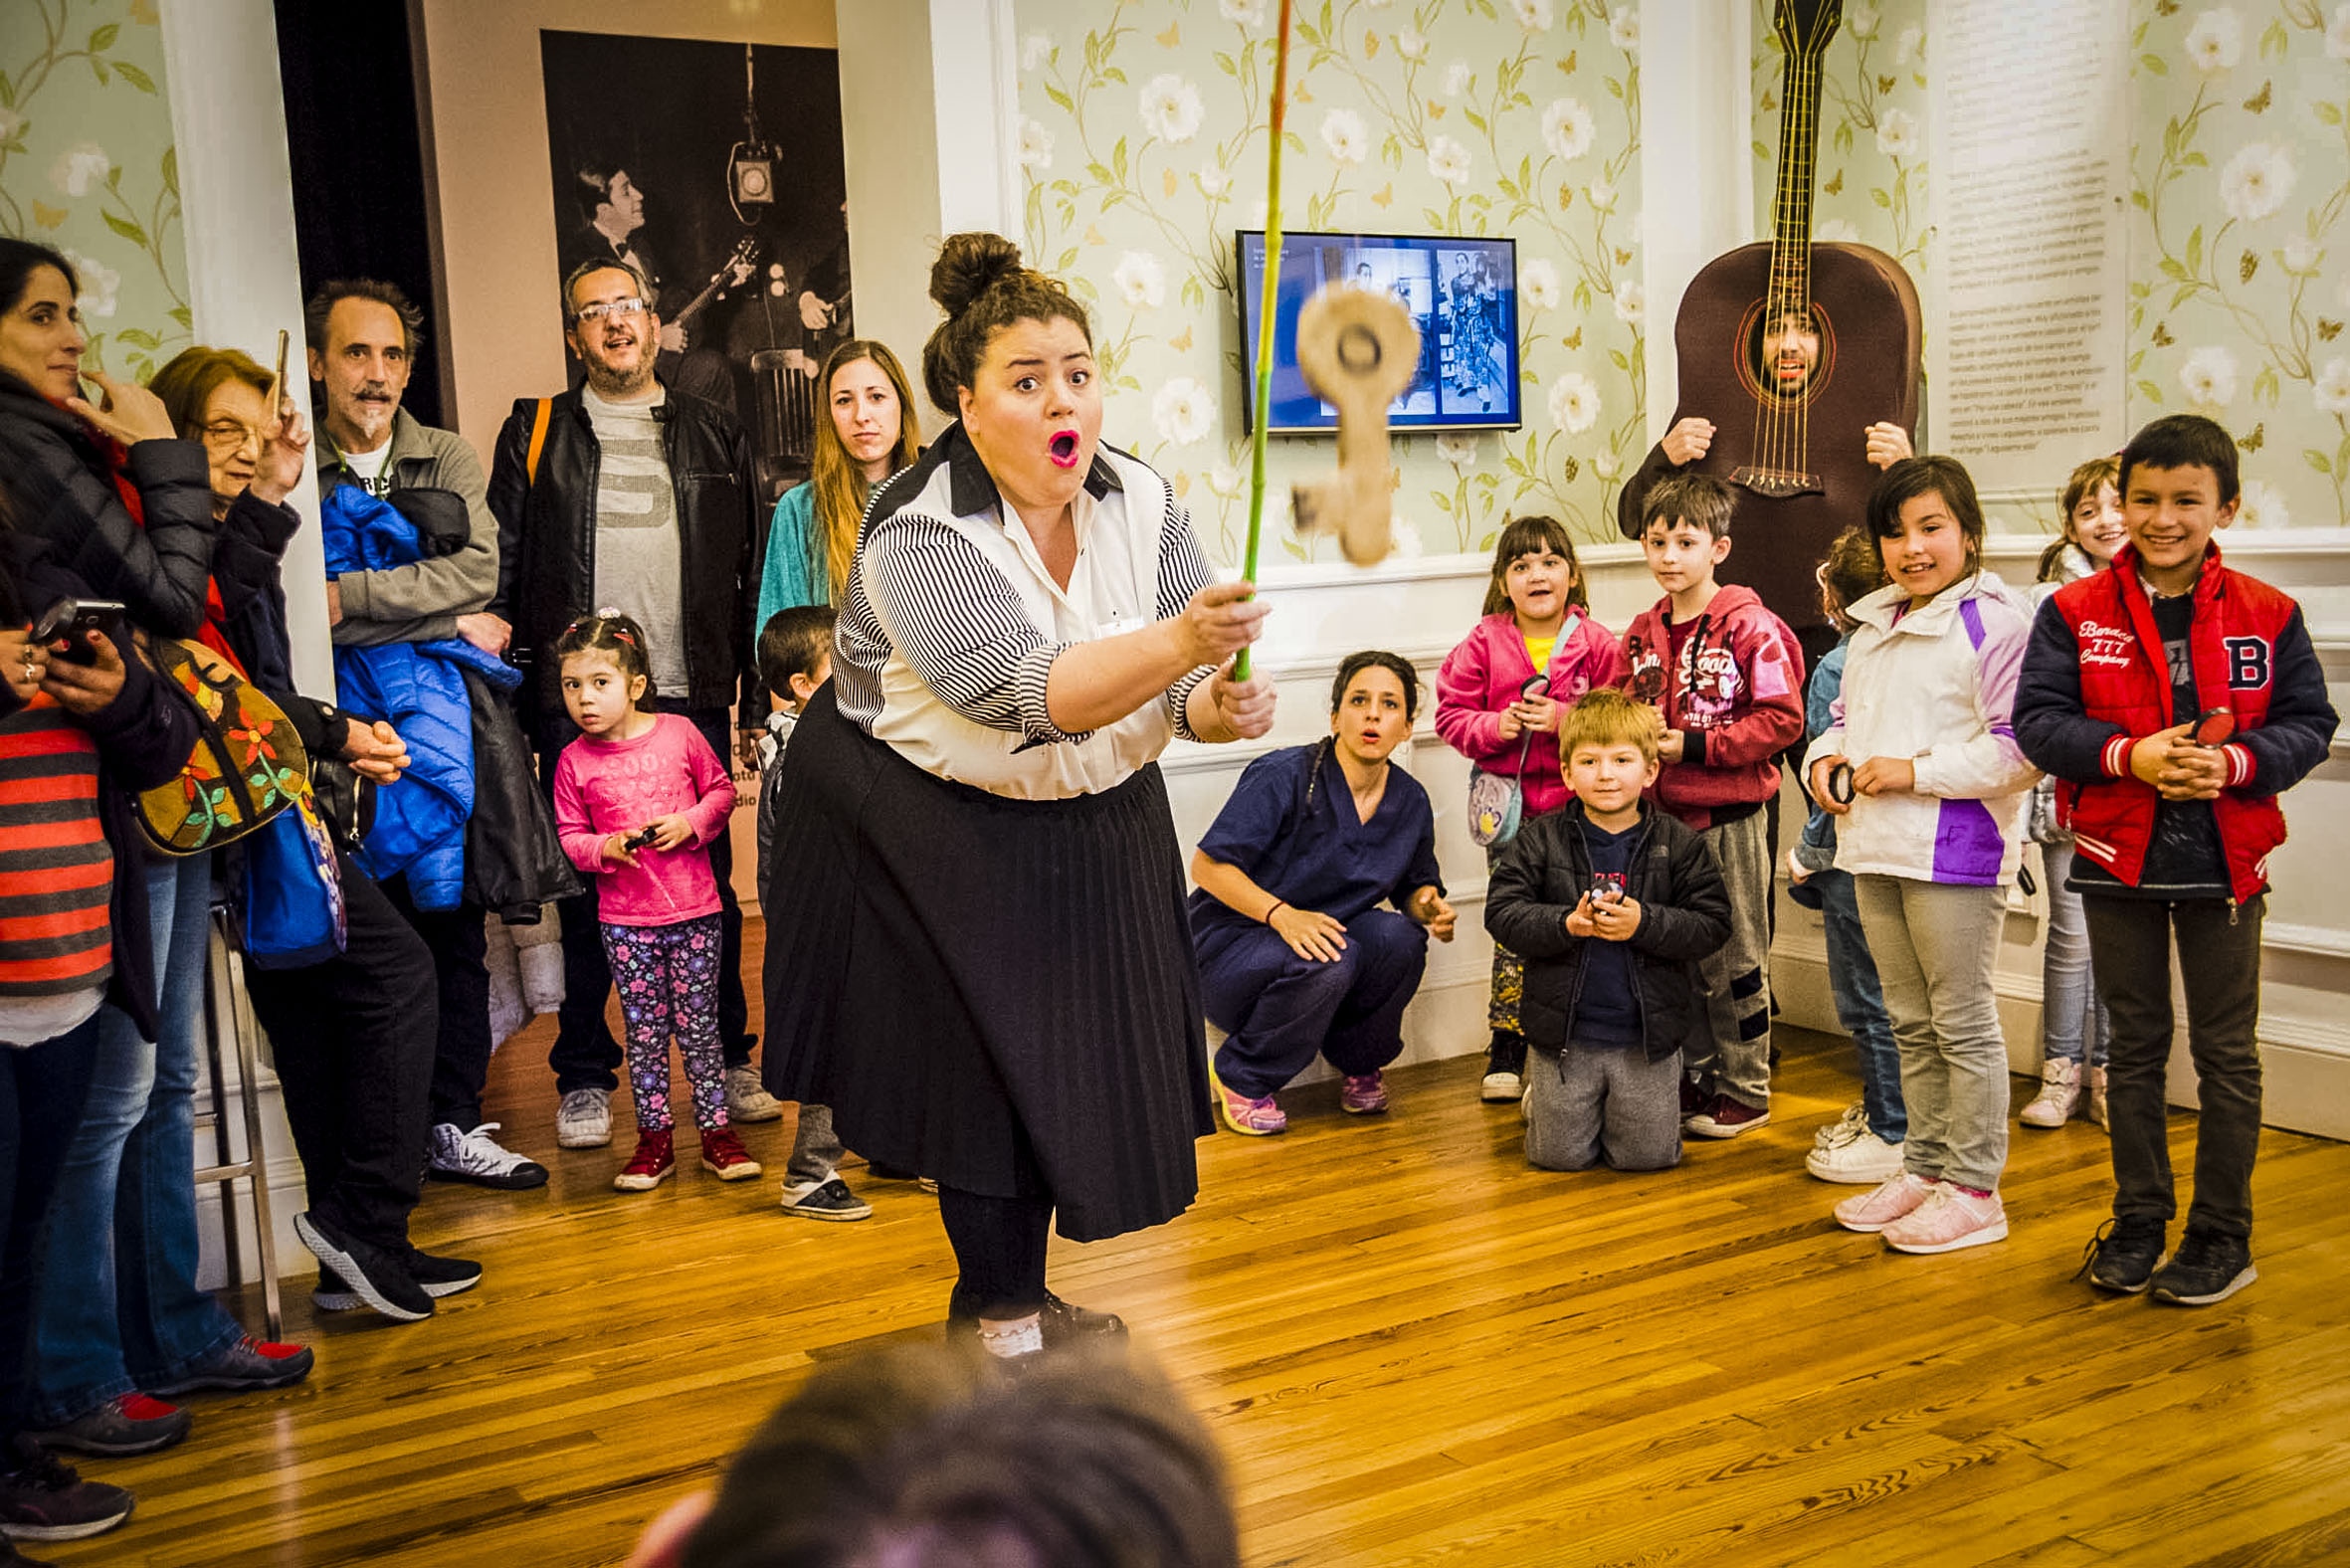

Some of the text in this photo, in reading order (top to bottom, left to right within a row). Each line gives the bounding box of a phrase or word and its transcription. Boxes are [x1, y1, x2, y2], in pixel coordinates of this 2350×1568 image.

[2091, 639, 2126, 655] 777
[2079, 649, 2131, 669] Company
[2223, 635, 2270, 690] B
